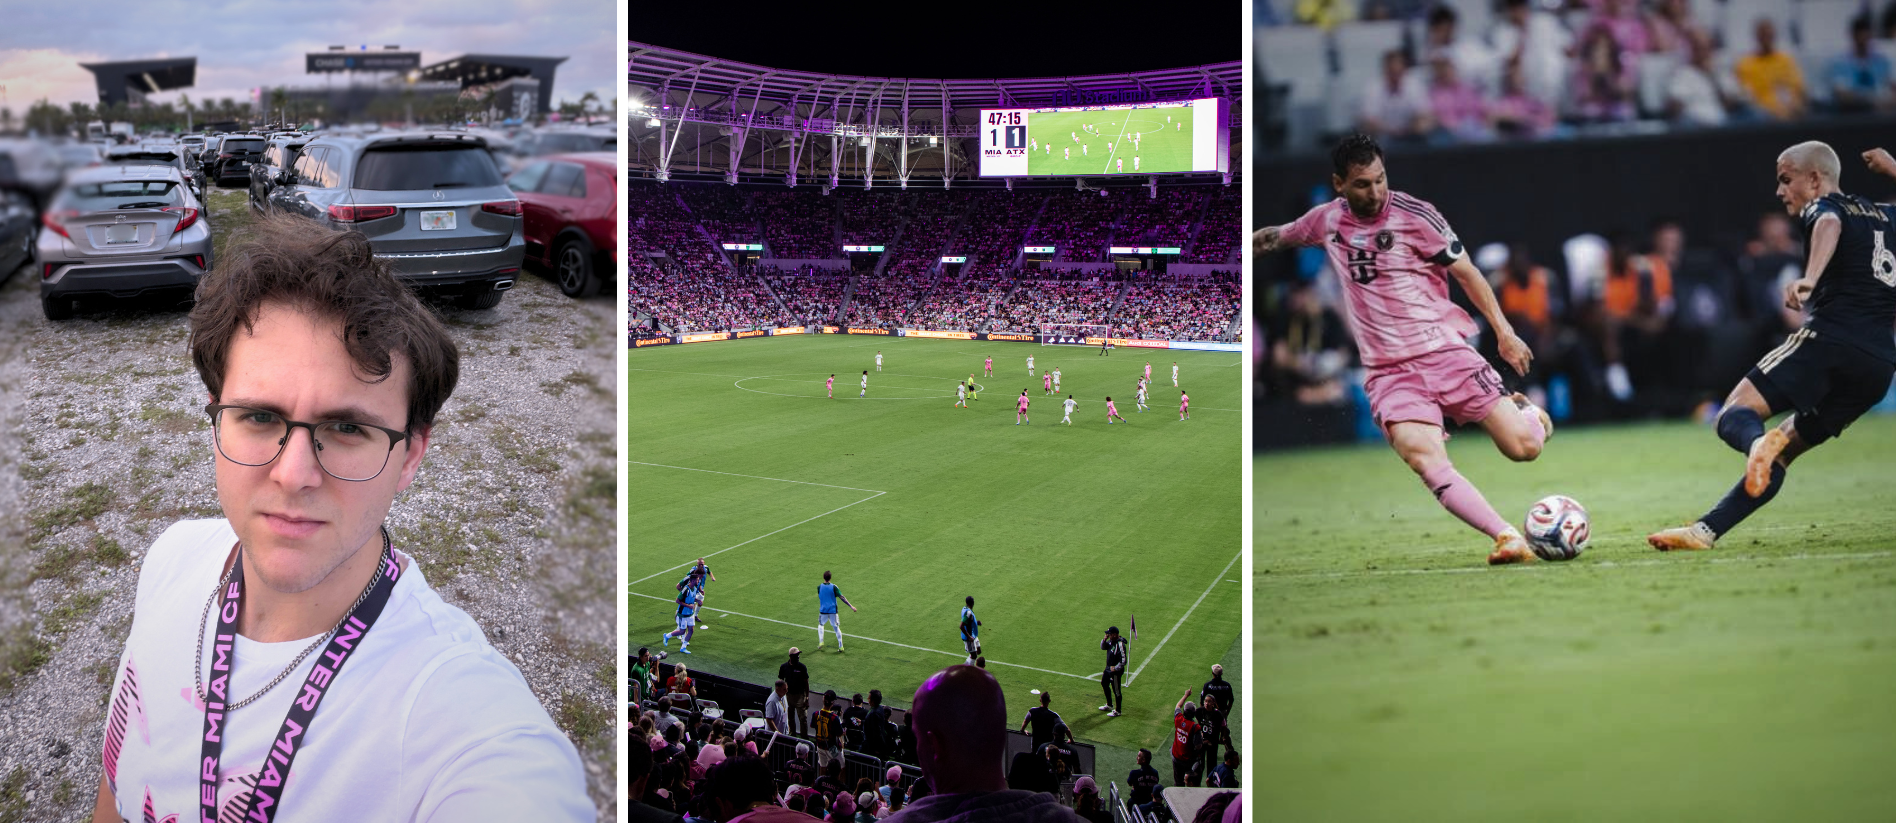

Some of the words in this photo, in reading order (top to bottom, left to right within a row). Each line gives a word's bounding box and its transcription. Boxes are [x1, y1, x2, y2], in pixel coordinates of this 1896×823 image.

[1085, 88, 1147, 104] Stadium
[988, 112, 1021, 125] 47:15
[990, 129, 997, 146] 1
[1012, 128, 1020, 146] 1
[987, 333, 1017, 341] Continental
[205, 634, 233, 743] MIAMI
[221, 581, 240, 624] CF
[295, 616, 368, 712] INTER
[246, 718, 303, 823] MIAM
